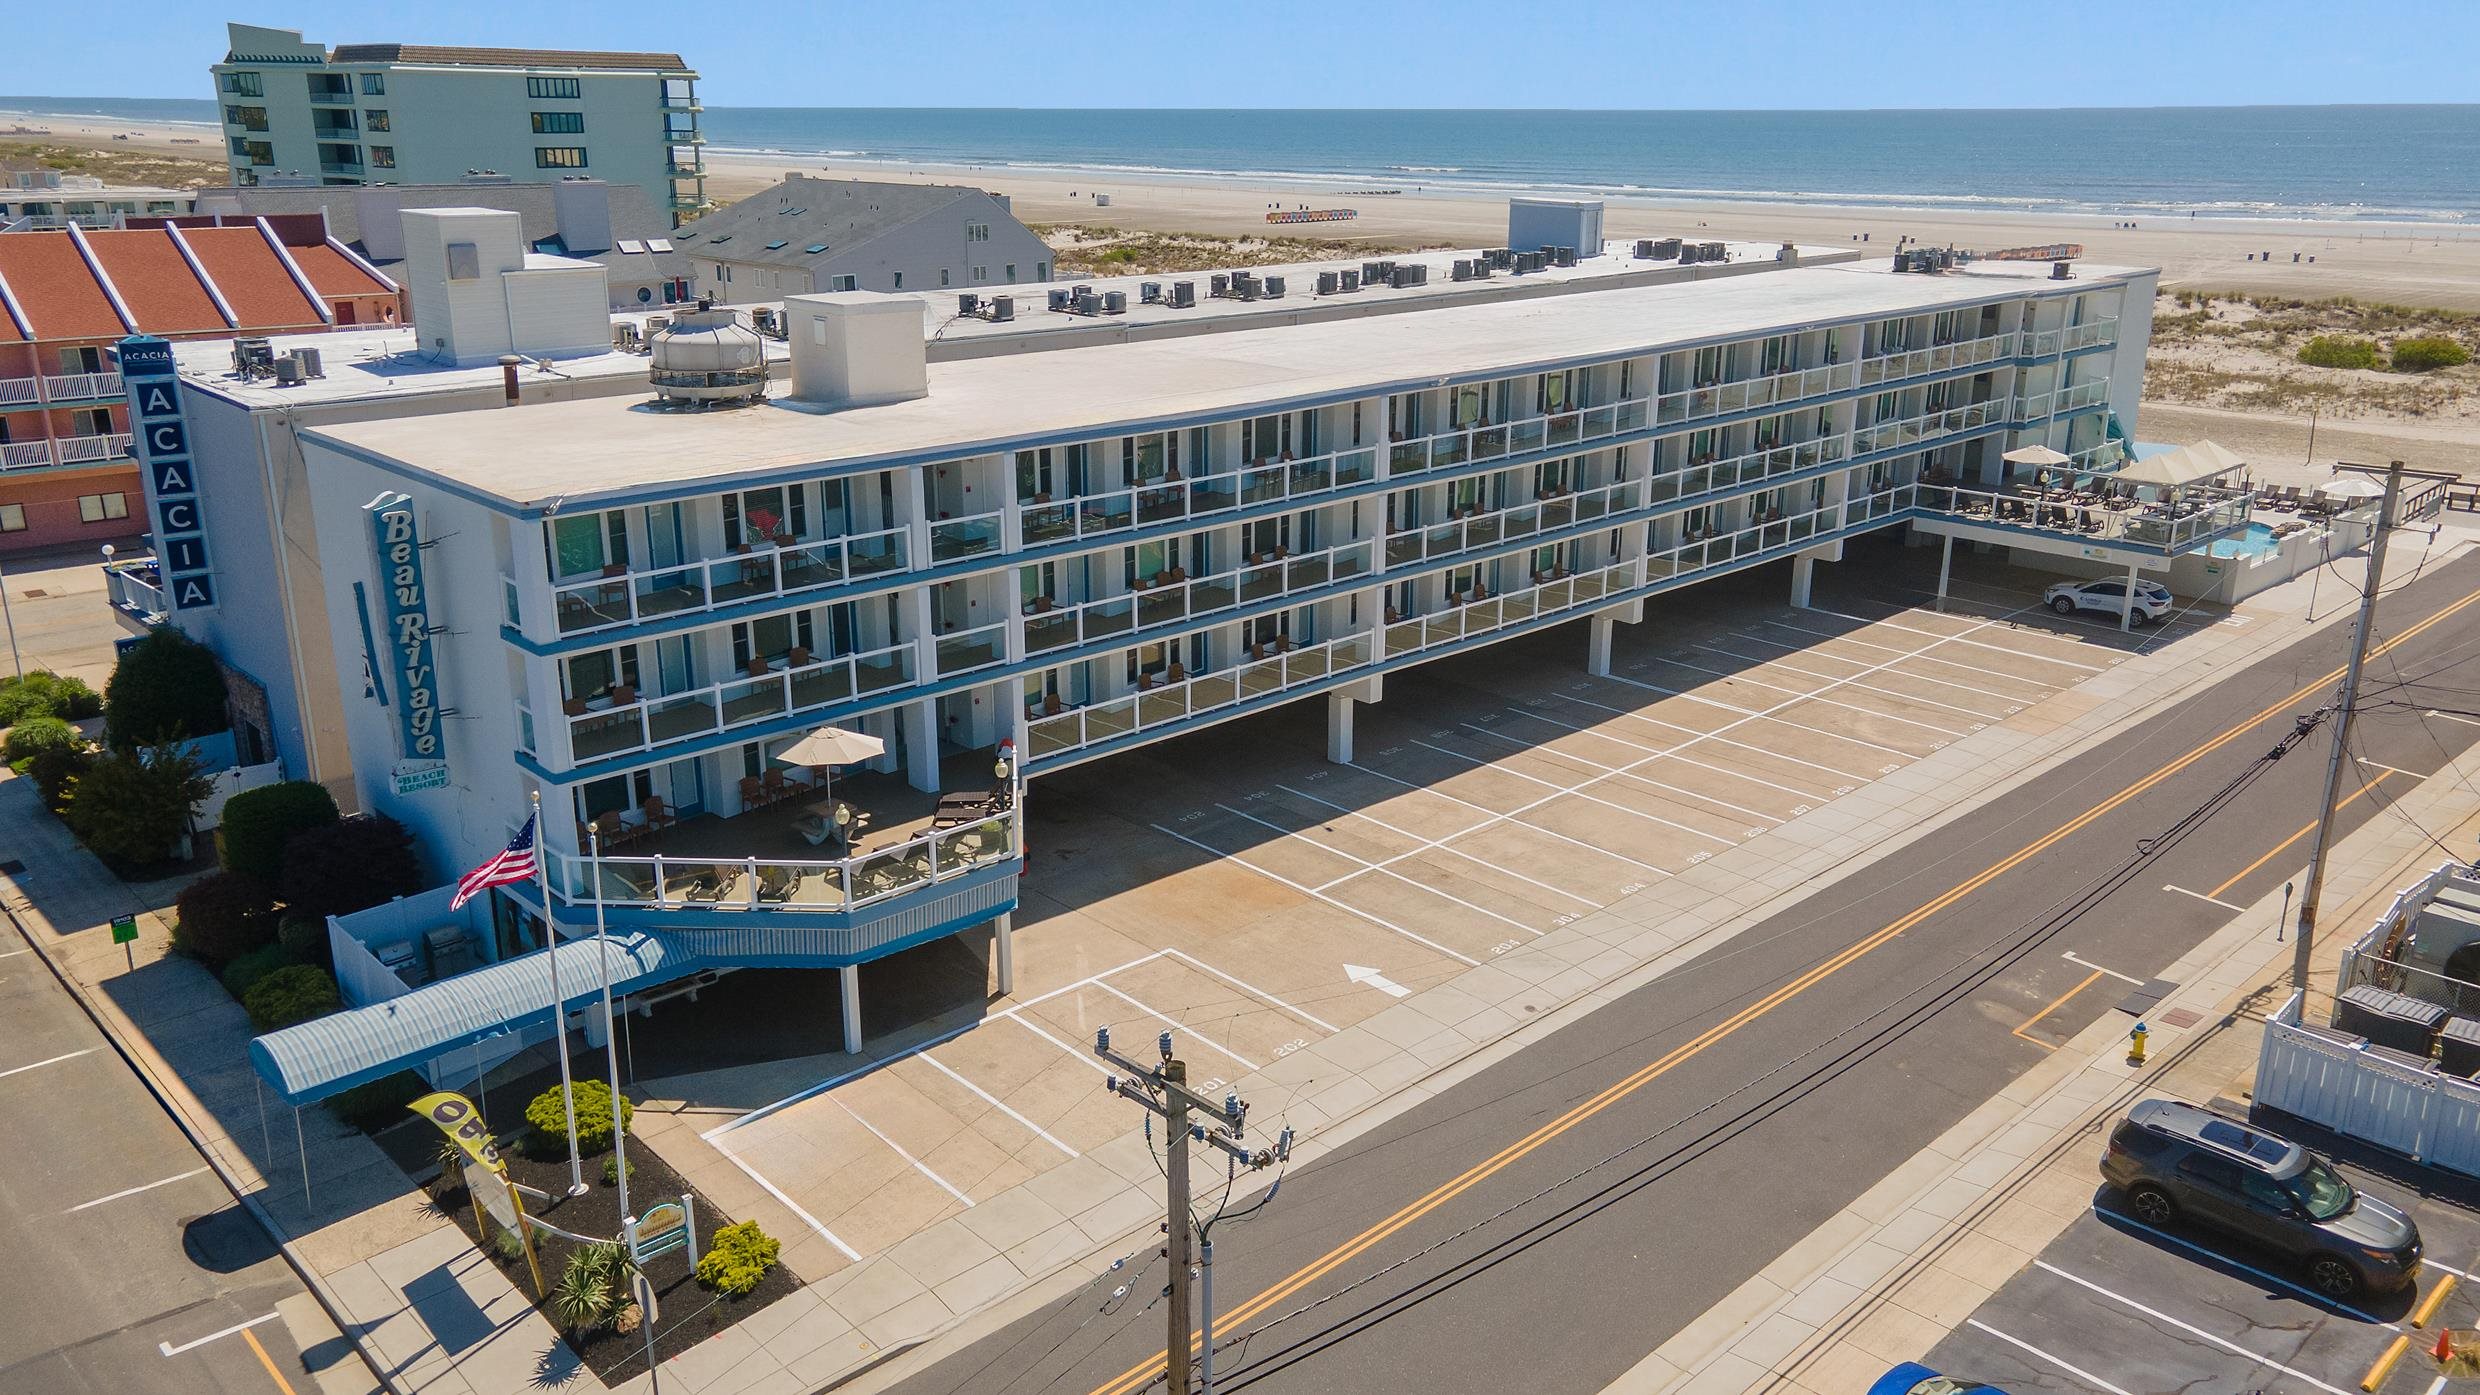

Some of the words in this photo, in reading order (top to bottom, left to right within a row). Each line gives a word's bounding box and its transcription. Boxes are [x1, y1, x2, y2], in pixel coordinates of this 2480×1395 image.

[124, 351, 170, 361] ACACIA
[147, 387, 206, 604] ACACIA
[381, 510, 420, 607] Beau
[395, 612, 436, 756] Rivage
[397, 769, 446, 785] BEACH
[399, 777, 446, 794] RESORT
[1552, 912, 1583, 926] 304
[1491, 938, 1521, 955] 204
[1273, 1039, 1310, 1057] 202
[1192, 1077, 1228, 1096] 201
